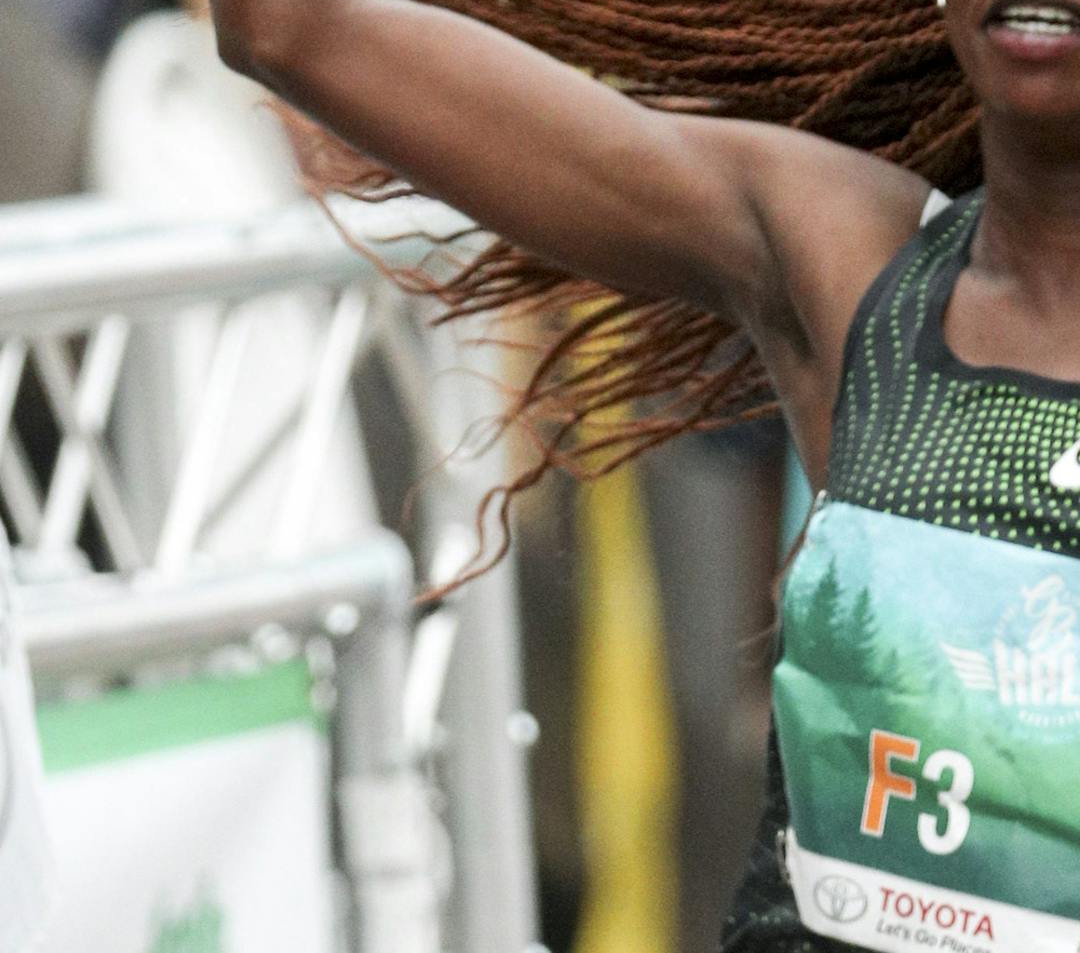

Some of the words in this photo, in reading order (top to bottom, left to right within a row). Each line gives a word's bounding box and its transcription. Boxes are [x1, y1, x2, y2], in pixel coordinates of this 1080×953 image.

[860, 728, 975, 856] F3
[878, 885, 995, 942] TOYOTA
[914, 928, 938, 948] Go
